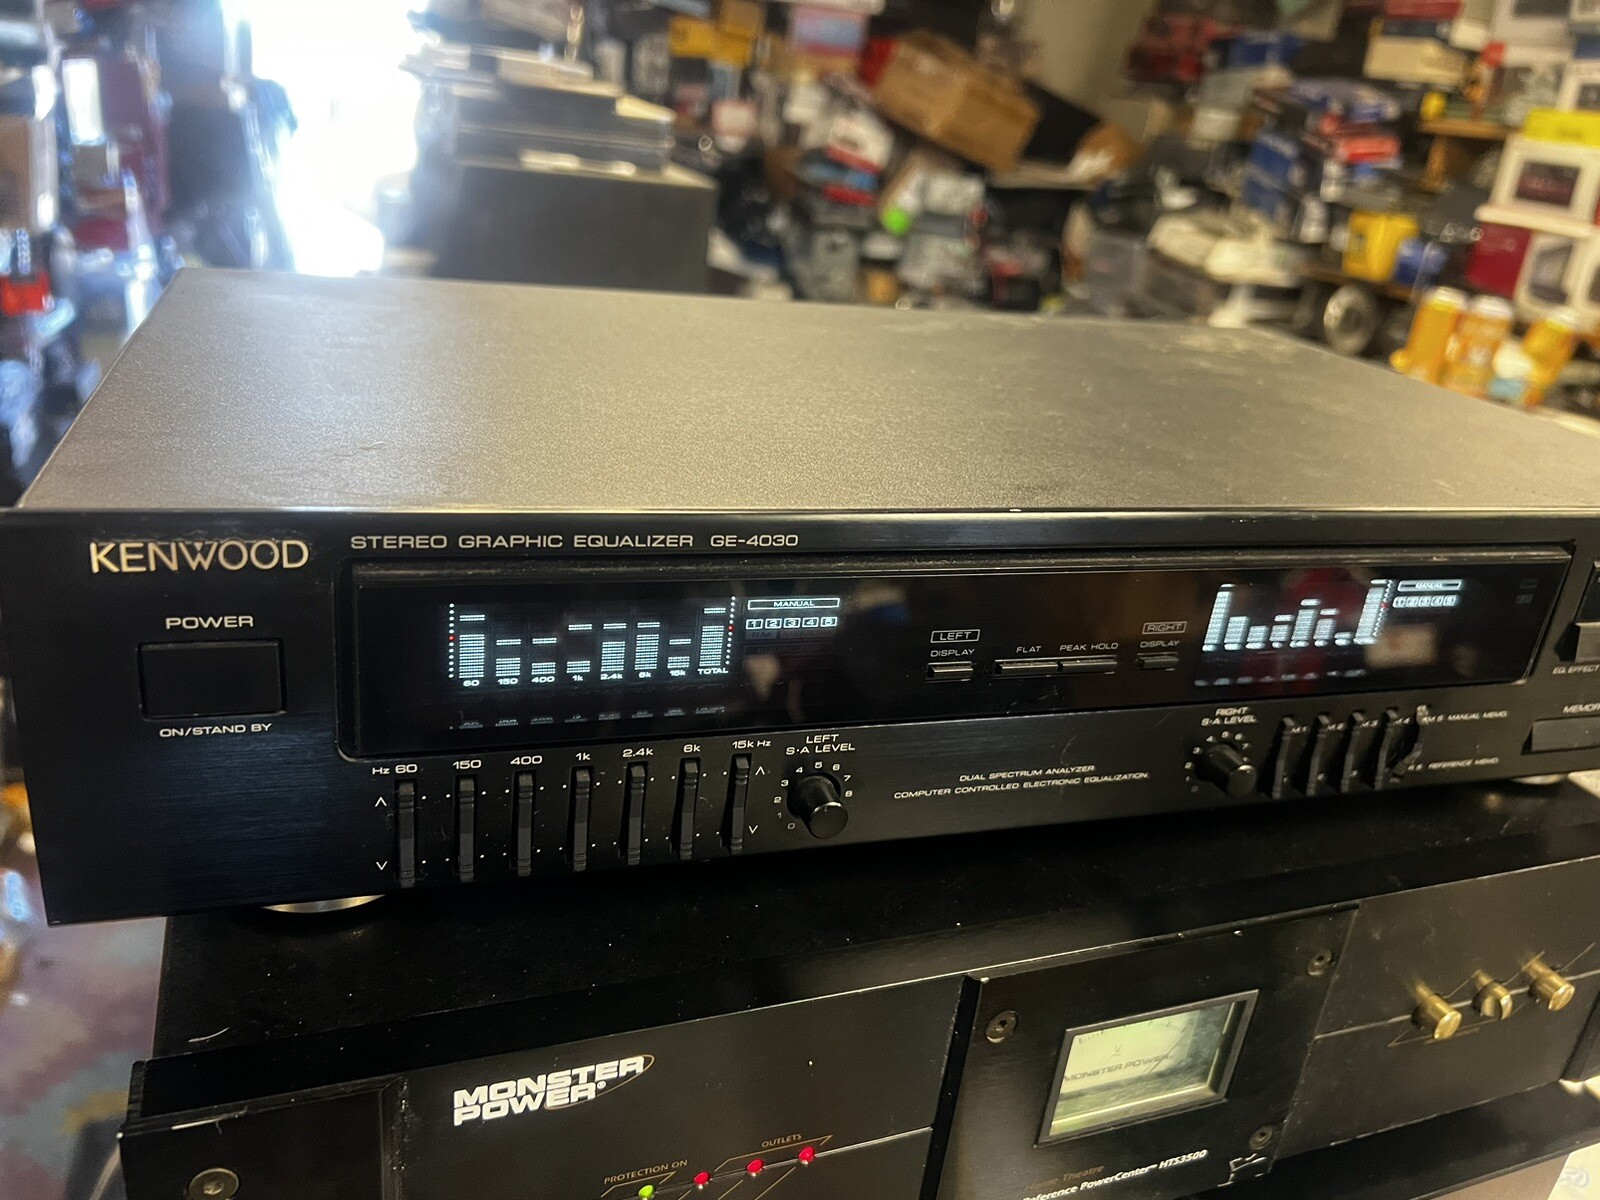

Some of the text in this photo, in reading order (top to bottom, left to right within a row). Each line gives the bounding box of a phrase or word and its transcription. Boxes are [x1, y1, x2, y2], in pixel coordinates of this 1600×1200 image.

[350, 534, 798, 549] STEREO GRAPHIC EQUALIZER GE-4030
[89, 540, 310, 574] KENWOOD
[166, 615, 254, 629] POWER
[1147, 624, 1182, 632] RIGHT
[939, 631, 972, 641] LEFT
[1016, 645, 1042, 653] FLAT
[1140, 640, 1180, 648] DISPLAY
[930, 649, 975, 657] DISPLAY
[463, 679, 480, 687] 60
[497, 677, 519, 685] 150
[697, 667, 729, 675] TOTAL
[1215, 707, 1249, 716] RIGHT
[1224, 715, 1257, 725] LEVEL
[159, 722, 272, 737] ON/STAND BY
[806, 734, 839, 744] LEFT
[815, 743, 856, 754] LEVEL
[372, 739, 772, 775] Hz 60 150 400 1k 2.4k 6k 15k Hz
[959, 765, 1096, 782] DUAL SPECTRUM ANALYZER
[894, 772, 1149, 799] COMPUTER CONTROLLED ELECTRONIC EQUALIZATION
[453, 1055, 646, 1109] MONSTER
[761, 1133, 802, 1148] OUTLETS
[1158, 1149, 1208, 1170] HTS3500
[604, 1159, 689, 1185] PROTECTION ON
